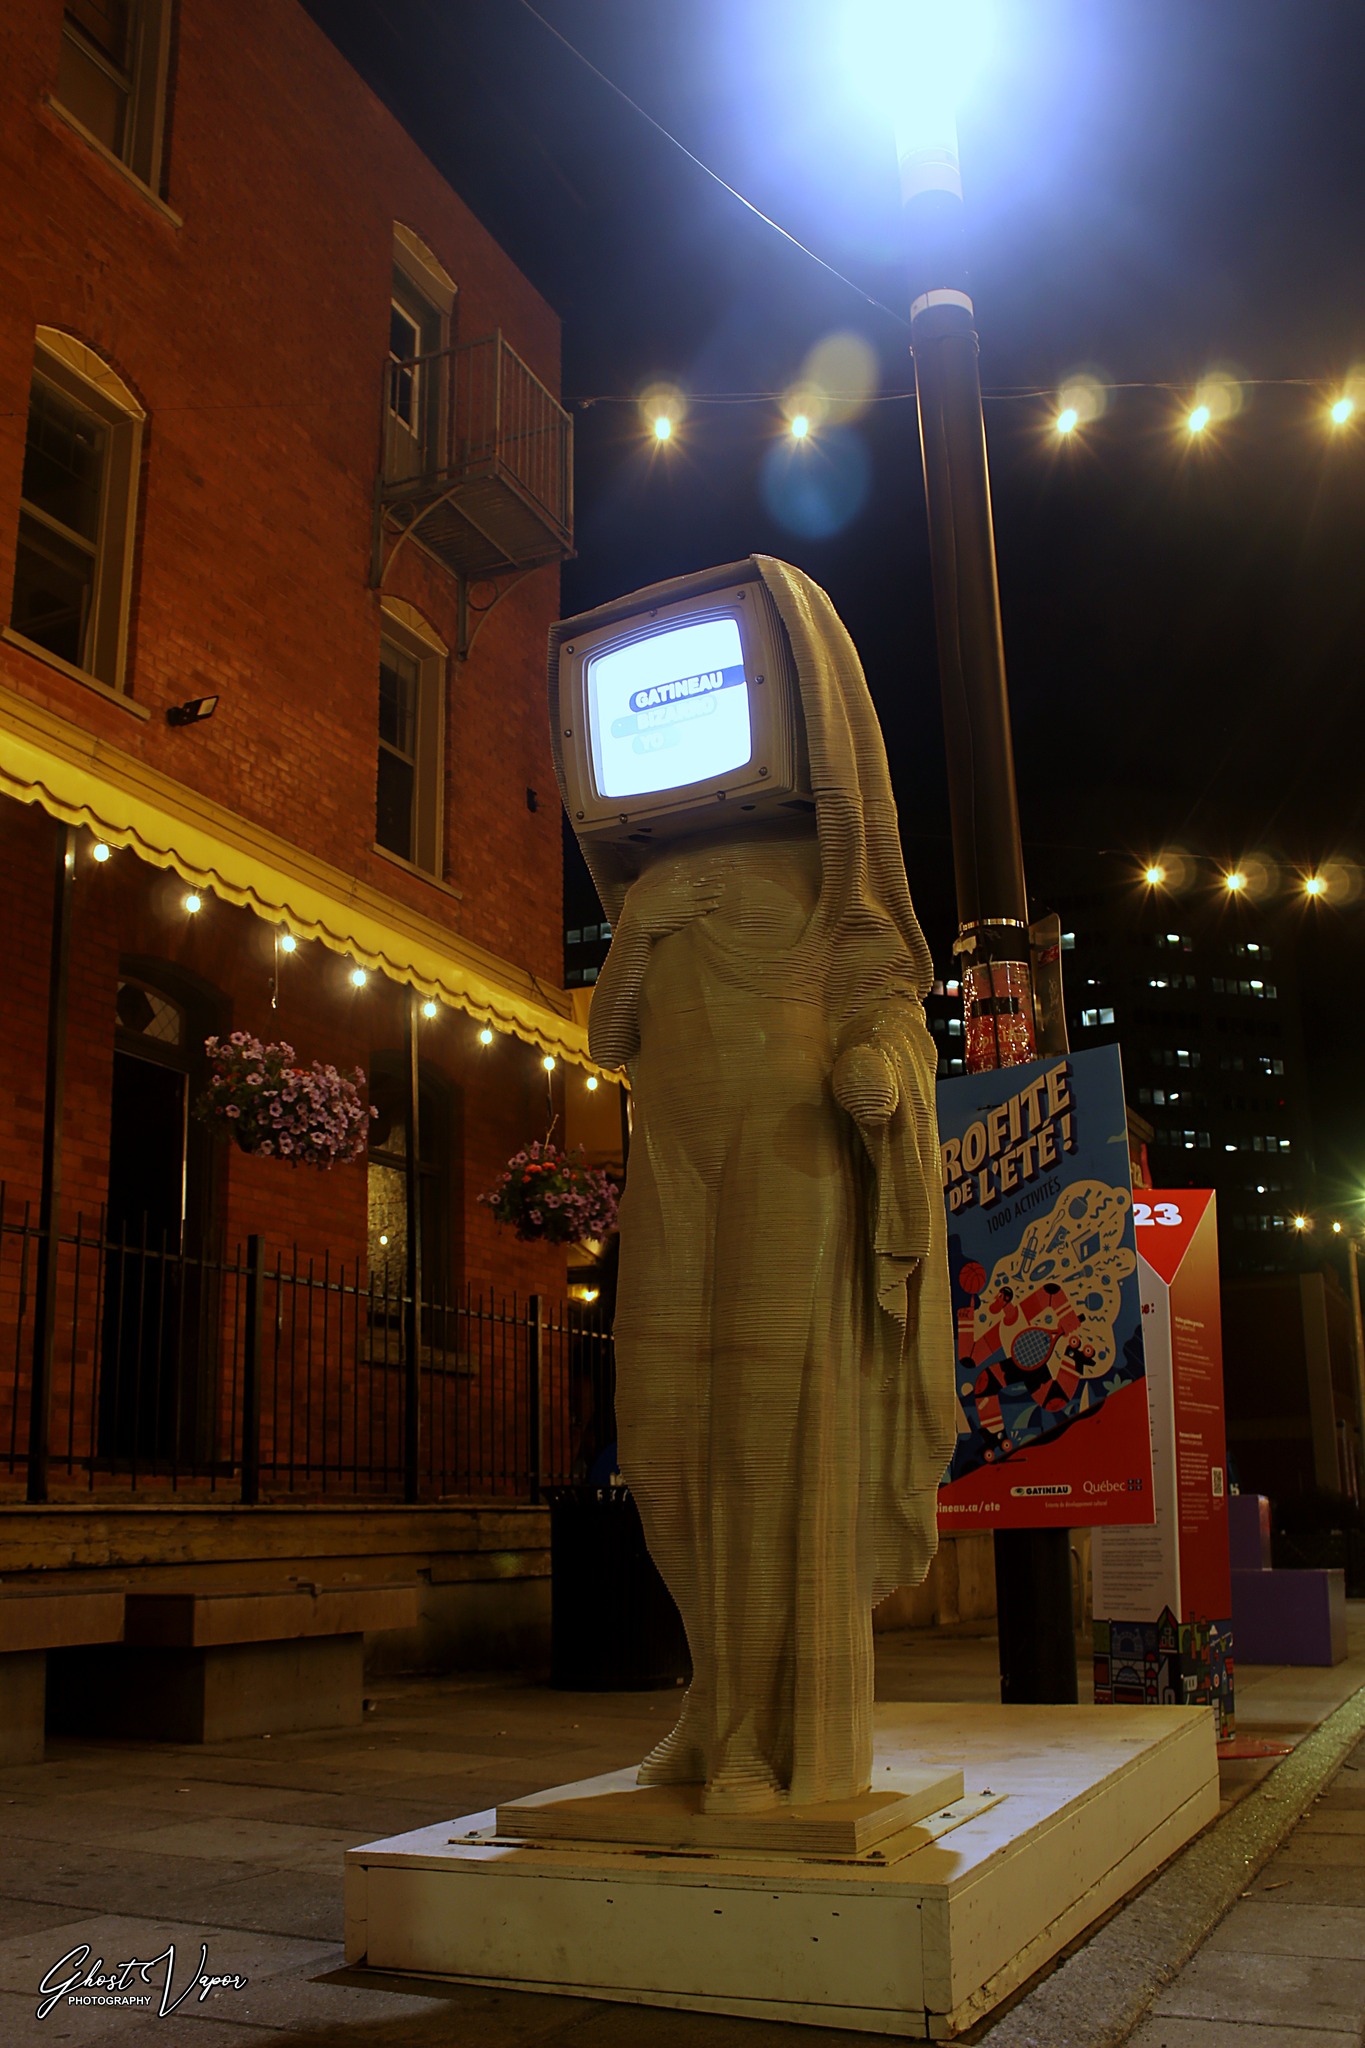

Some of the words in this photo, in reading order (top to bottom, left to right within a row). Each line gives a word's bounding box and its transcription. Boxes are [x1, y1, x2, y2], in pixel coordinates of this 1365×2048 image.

[635, 671, 724, 708] GATINEAU
[941, 1060, 1073, 1186] ROFITE
[950, 1178, 974, 1212] DE
[987, 1210, 1012, 1234] 1000
[1015, 1176, 1061, 1218] ACTIVITÉS
[1026, 1486, 1069, 1495] GATINEAU
[1083, 1479, 1125, 1494] Québec
[937, 1501, 1000, 1513] ineau.ca/ete
